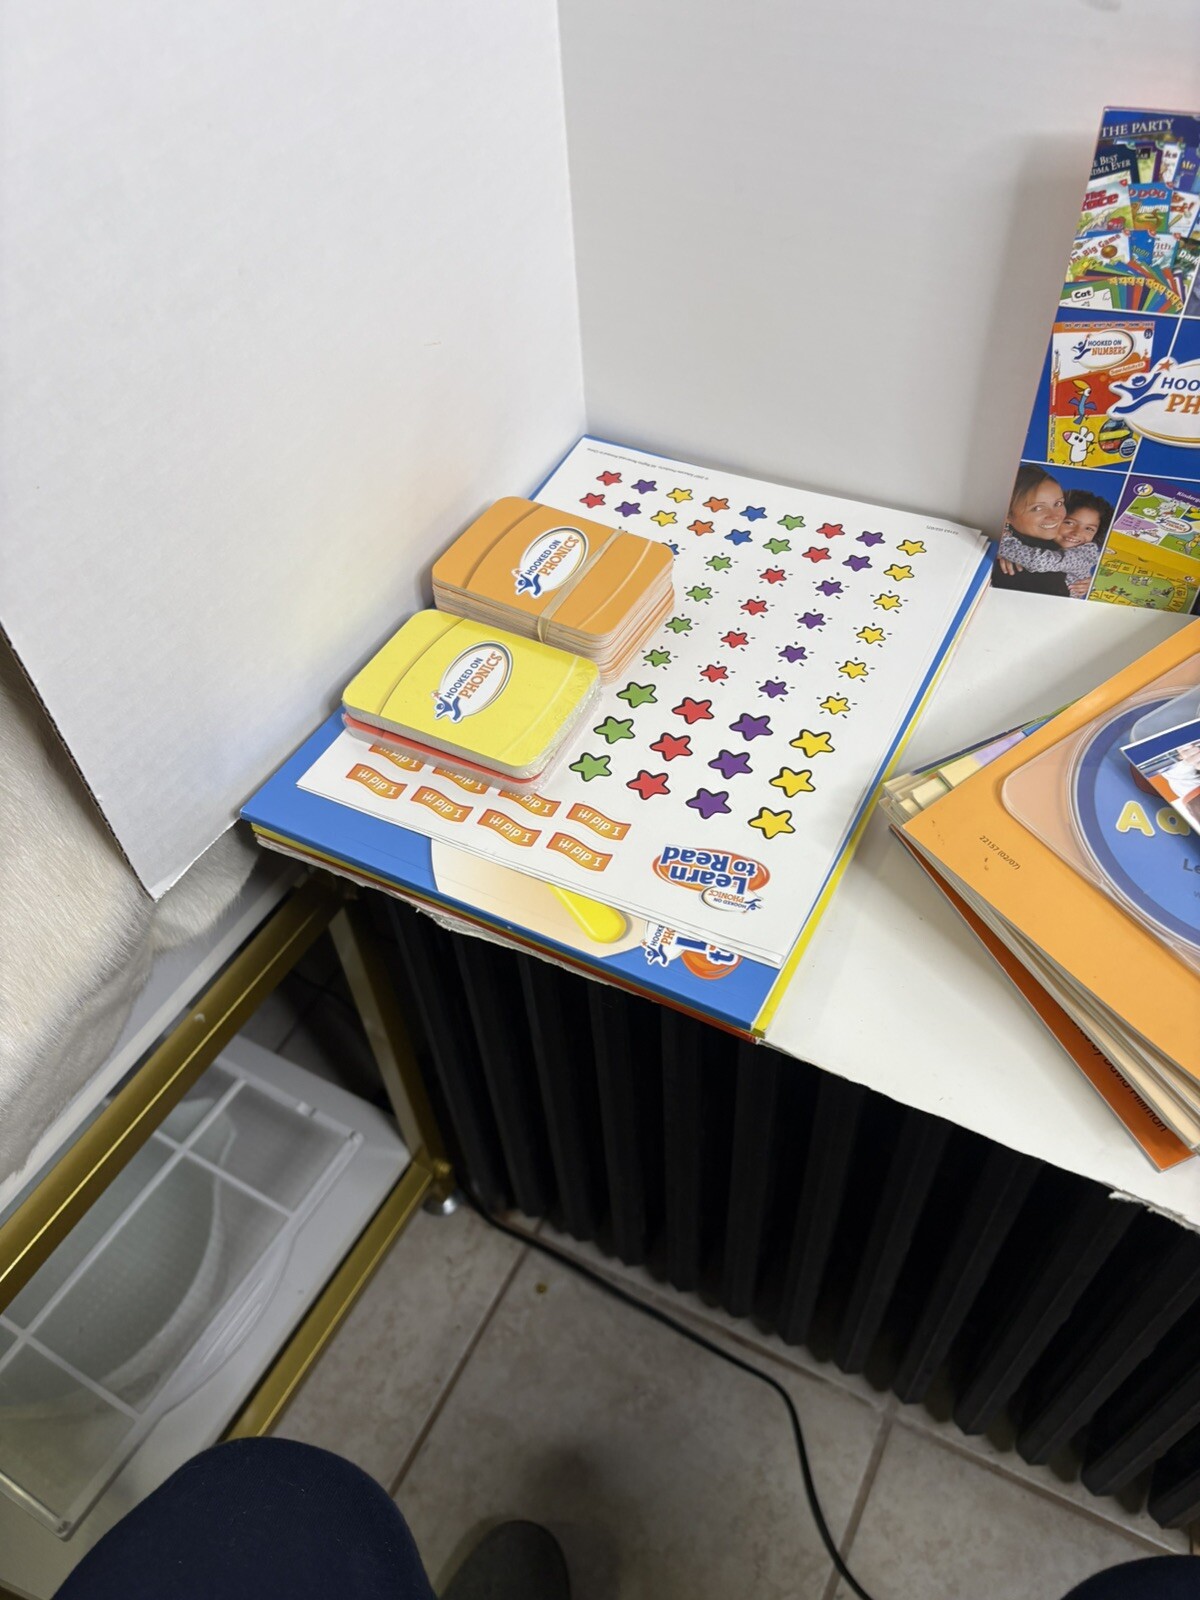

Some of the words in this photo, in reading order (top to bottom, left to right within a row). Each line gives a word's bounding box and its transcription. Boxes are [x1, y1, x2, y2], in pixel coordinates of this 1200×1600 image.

[1102, 124, 1128, 137] THE
[1132, 119, 1174, 134] PARTY
[1082, 246, 1098, 257] Big
[1098, 234, 1121, 249] Game
[1074, 290, 1092, 299] Cat
[1091, 346, 1127, 356] NUMBERS
[524, 548, 551, 576] HOOKED
[549, 539, 561, 552] ON
[538, 535, 580, 577] PHONICS
[446, 669, 474, 699] HOOKED
[471, 657, 483, 671] ON
[459, 651, 503, 700] PHONICS
[357, 769, 370, 779] it!
[370, 777, 388, 790] did
[388, 786, 397, 795] I
[422, 792, 435, 802] it!
[434, 799, 453, 813] did
[521, 794, 541, 807] did
[453, 809, 464, 818] I
[542, 804, 552, 813] I
[577, 808, 591, 820] it!
[489, 815, 502, 826] it!
[591, 817, 610, 830] did
[502, 823, 521, 837] did
[611, 826, 622, 836] I
[521, 833, 532, 842] I
[558, 838, 572, 850] it!
[571, 847, 592, 861] did
[978, 834, 1000, 854] 22157
[997, 850, 1021, 870] (02/07)
[593, 857, 603, 867] I
[660, 846, 730, 872] Read
[733, 860, 756, 876] to
[669, 865, 748, 895] Learn
[709, 889, 745, 904] PHONICS
[723, 900, 747, 909] HOOKED
[650, 925, 665, 946] HOOKE
